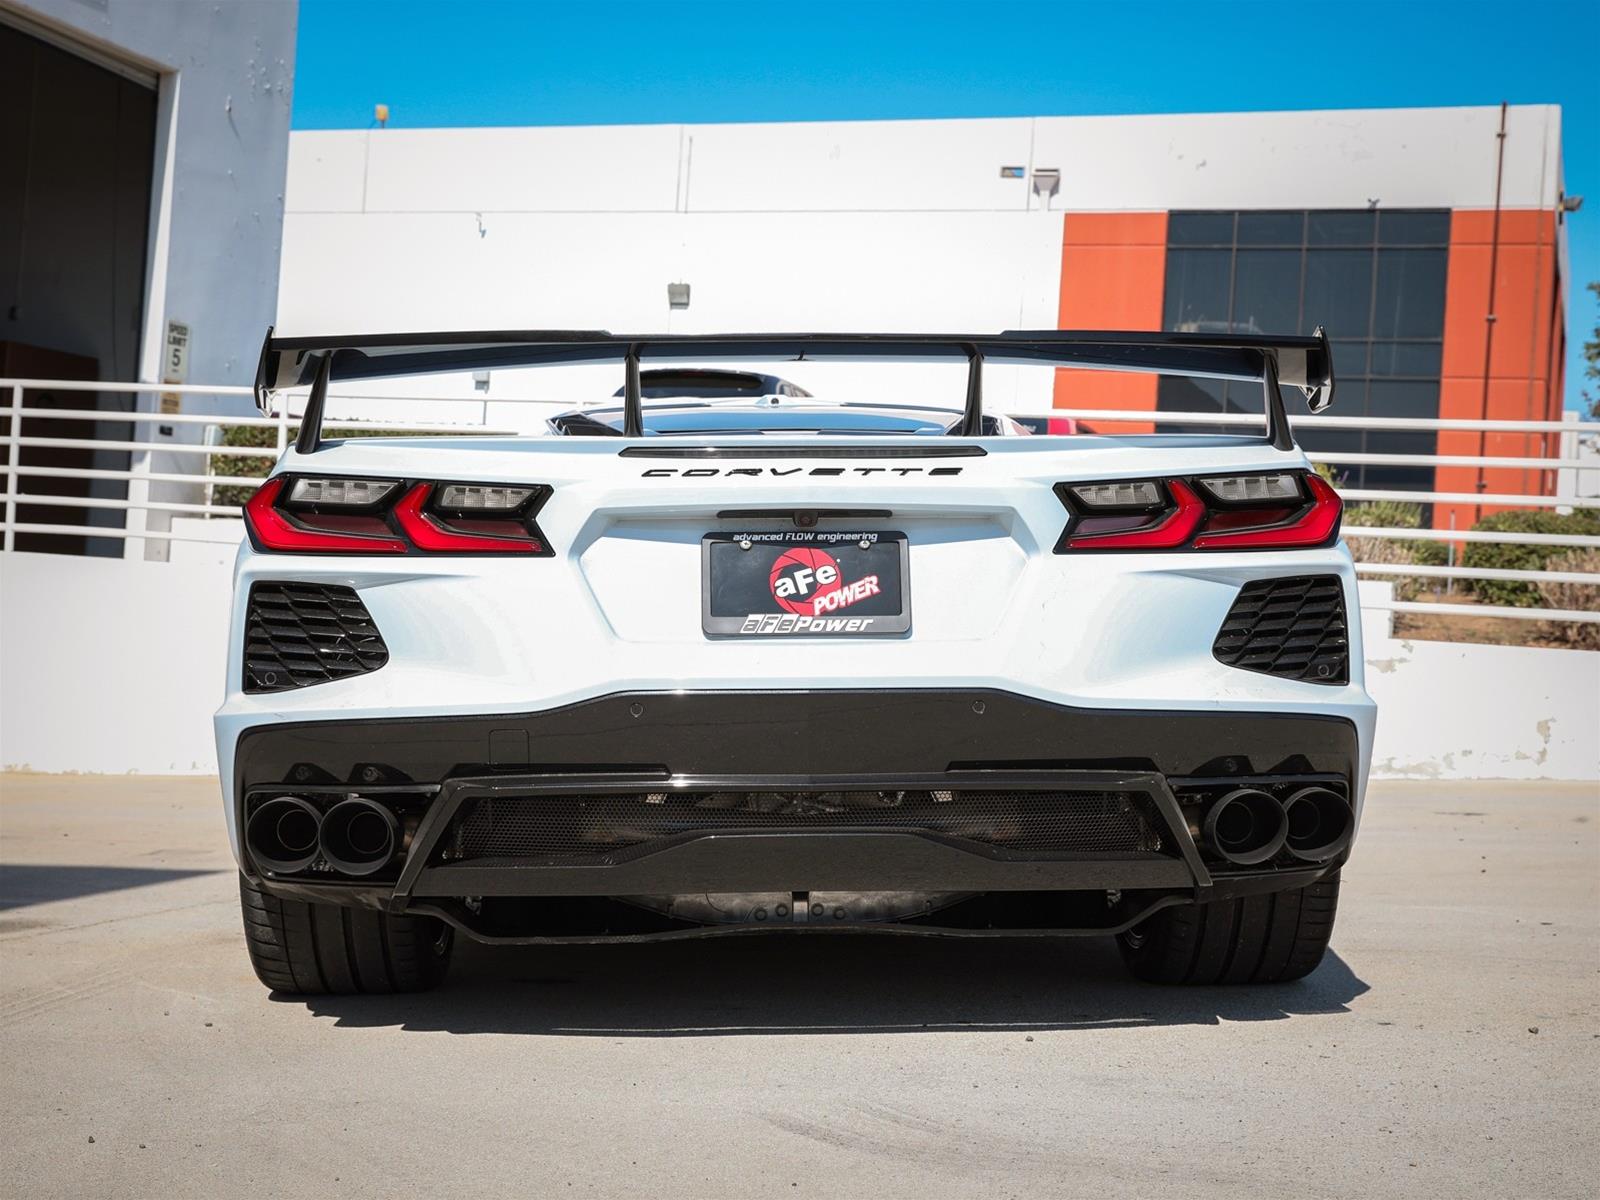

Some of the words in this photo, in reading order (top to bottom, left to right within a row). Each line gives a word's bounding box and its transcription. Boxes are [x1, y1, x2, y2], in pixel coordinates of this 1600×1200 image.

[172, 348, 181, 367] 5
[641, 467, 963, 477] CORVETTE
[733, 533, 783, 541] advanced
[785, 533, 815, 541] FLOW
[817, 532, 878, 542] engineering
[774, 564, 837, 598] aFe
[813, 575, 881, 616] POWER
